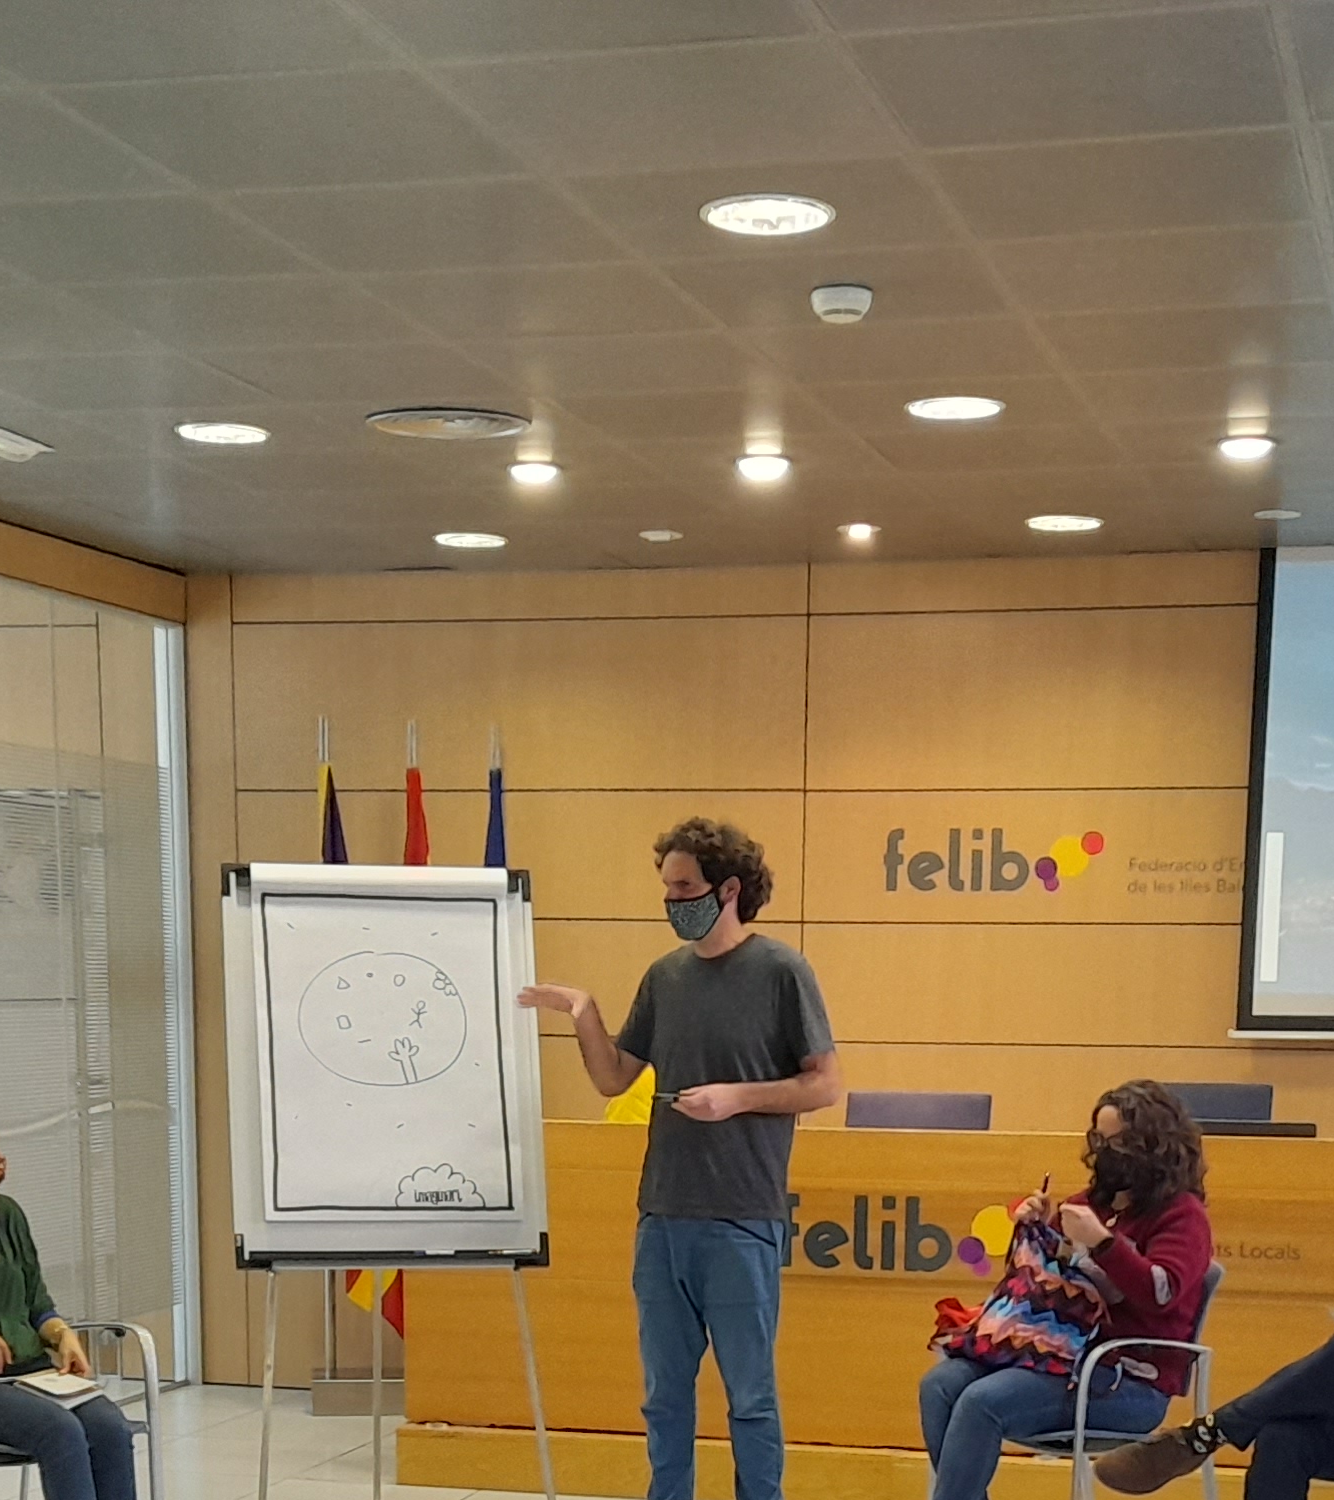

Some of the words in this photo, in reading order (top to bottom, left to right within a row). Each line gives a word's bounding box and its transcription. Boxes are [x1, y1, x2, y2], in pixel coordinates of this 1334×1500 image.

[883, 827, 1030, 892] felib
[1128, 857, 1207, 873] Federació
[1127, 879, 1148, 894] de
[781, 1193, 953, 1272] felib
[1239, 1242, 1301, 1260] Locals
